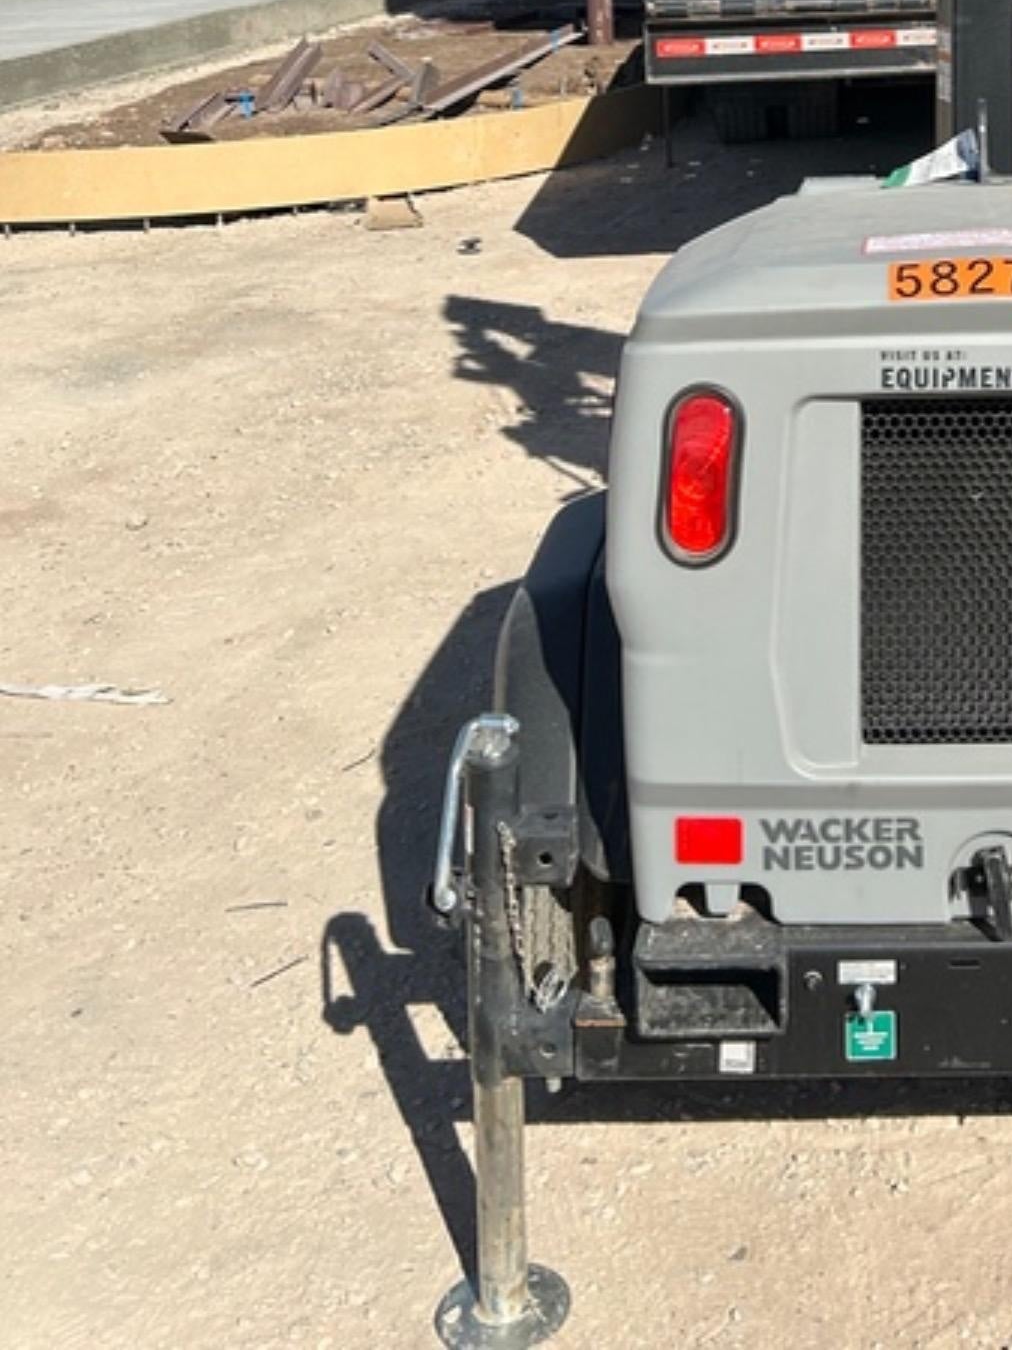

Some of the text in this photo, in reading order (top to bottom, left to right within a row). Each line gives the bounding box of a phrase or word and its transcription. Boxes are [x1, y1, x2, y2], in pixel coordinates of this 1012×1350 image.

[881, 350, 917, 362] VISIT
[922, 350, 941, 362] US
[759, 818, 922, 843] WACKER
[763, 845, 925, 872] NEUSON
